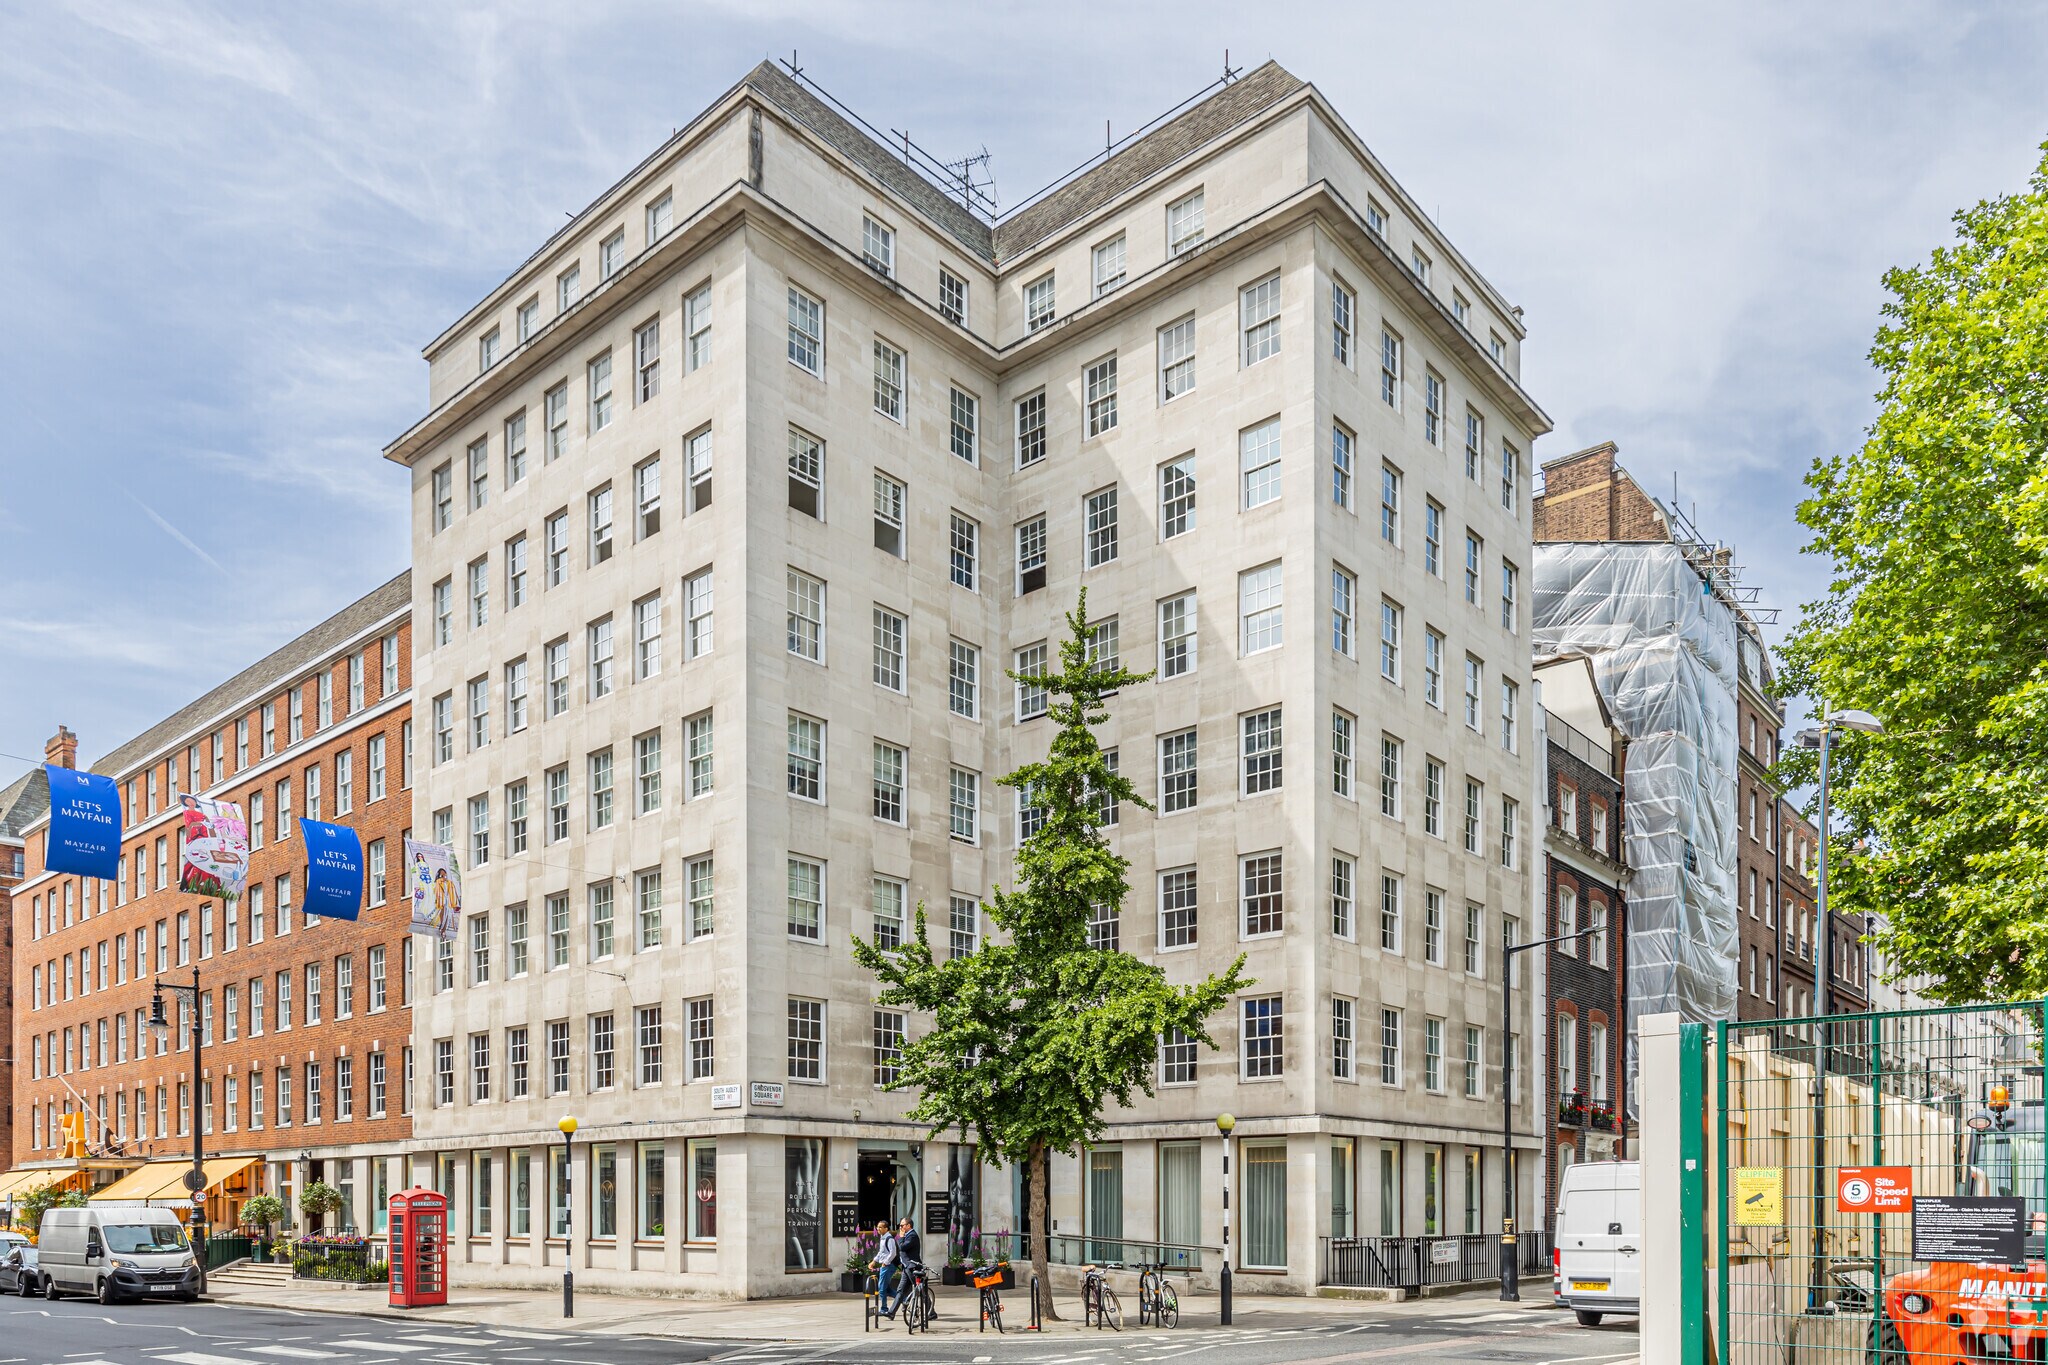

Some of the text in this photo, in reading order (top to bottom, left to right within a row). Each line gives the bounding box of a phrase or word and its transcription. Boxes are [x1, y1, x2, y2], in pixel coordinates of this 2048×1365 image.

[72, 799, 102, 813] LET'S
[61, 808, 112, 825] MAYFAIR
[64, 839, 106, 852] MAYFAIR
[323, 850, 348, 861] LET'S
[316, 858, 356, 872] MAYFAIR
[319, 885, 352, 897] MAYFAIR
[754, 1084, 782, 1093] GROSVENOR
[1739, 1170, 1778, 1178] CLIPFINE
[1874, 1177, 1896, 1187] Site
[1851, 1183, 1861, 1196] 5
[1874, 1187, 1909, 1197] Speed
[1874, 1197, 1901, 1206] Limit
